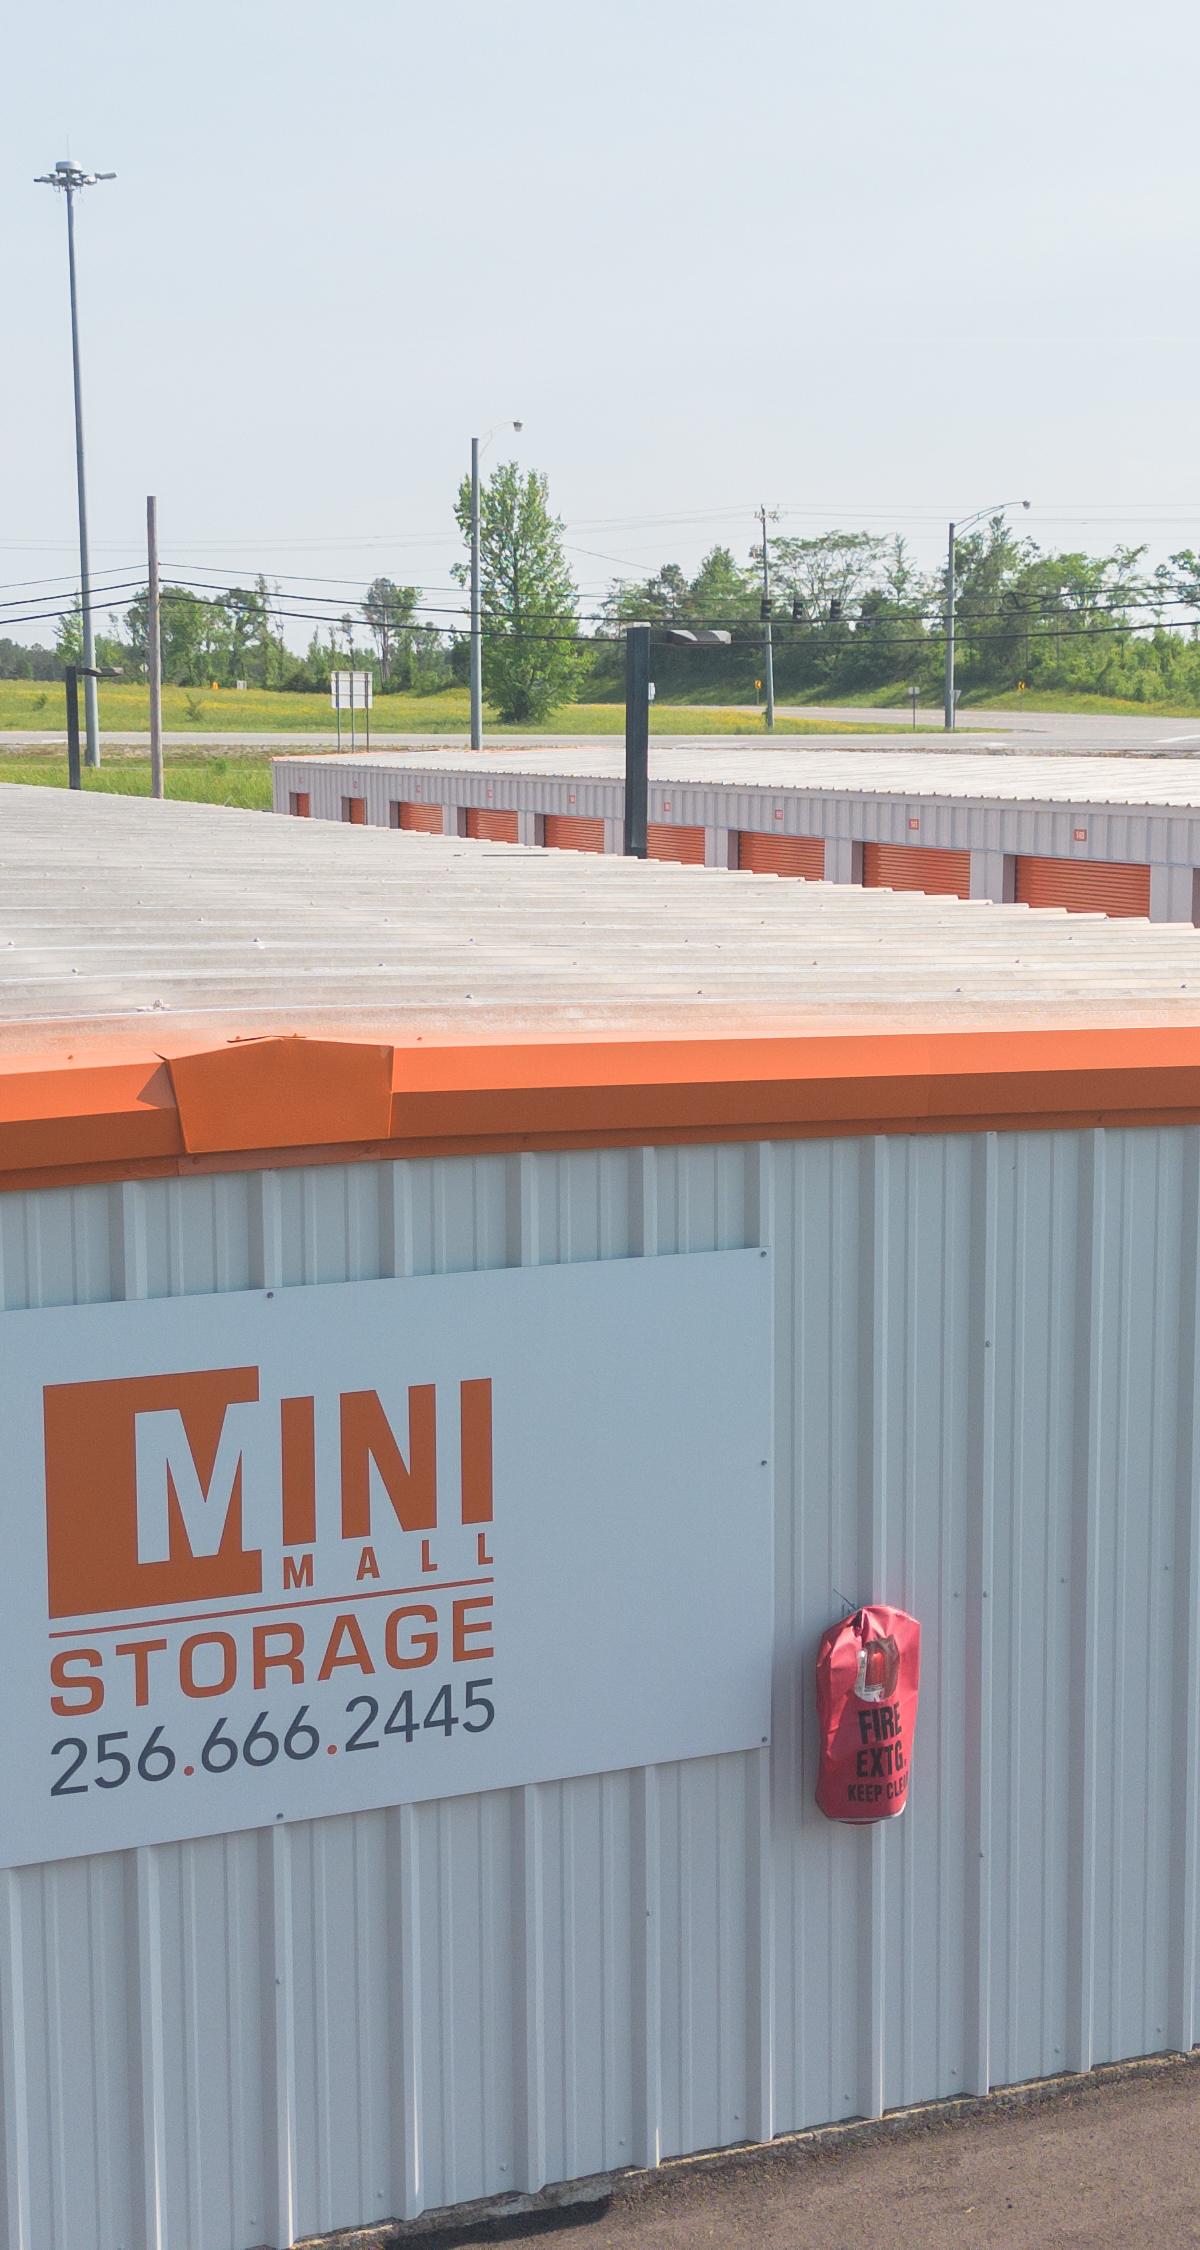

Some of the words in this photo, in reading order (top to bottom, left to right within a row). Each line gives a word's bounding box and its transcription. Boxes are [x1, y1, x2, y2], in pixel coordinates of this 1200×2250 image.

[134, 1378, 494, 1565] MINI
[283, 1532, 494, 1590] MALL
[50, 1596, 494, 1717] STORAGE
[50, 1678, 495, 1796] 256.666.2445
[858, 1702, 902, 1745] FIRE
[856, 1741, 907, 1777] EXTG.
[847, 1784, 882, 1802] KEEP
